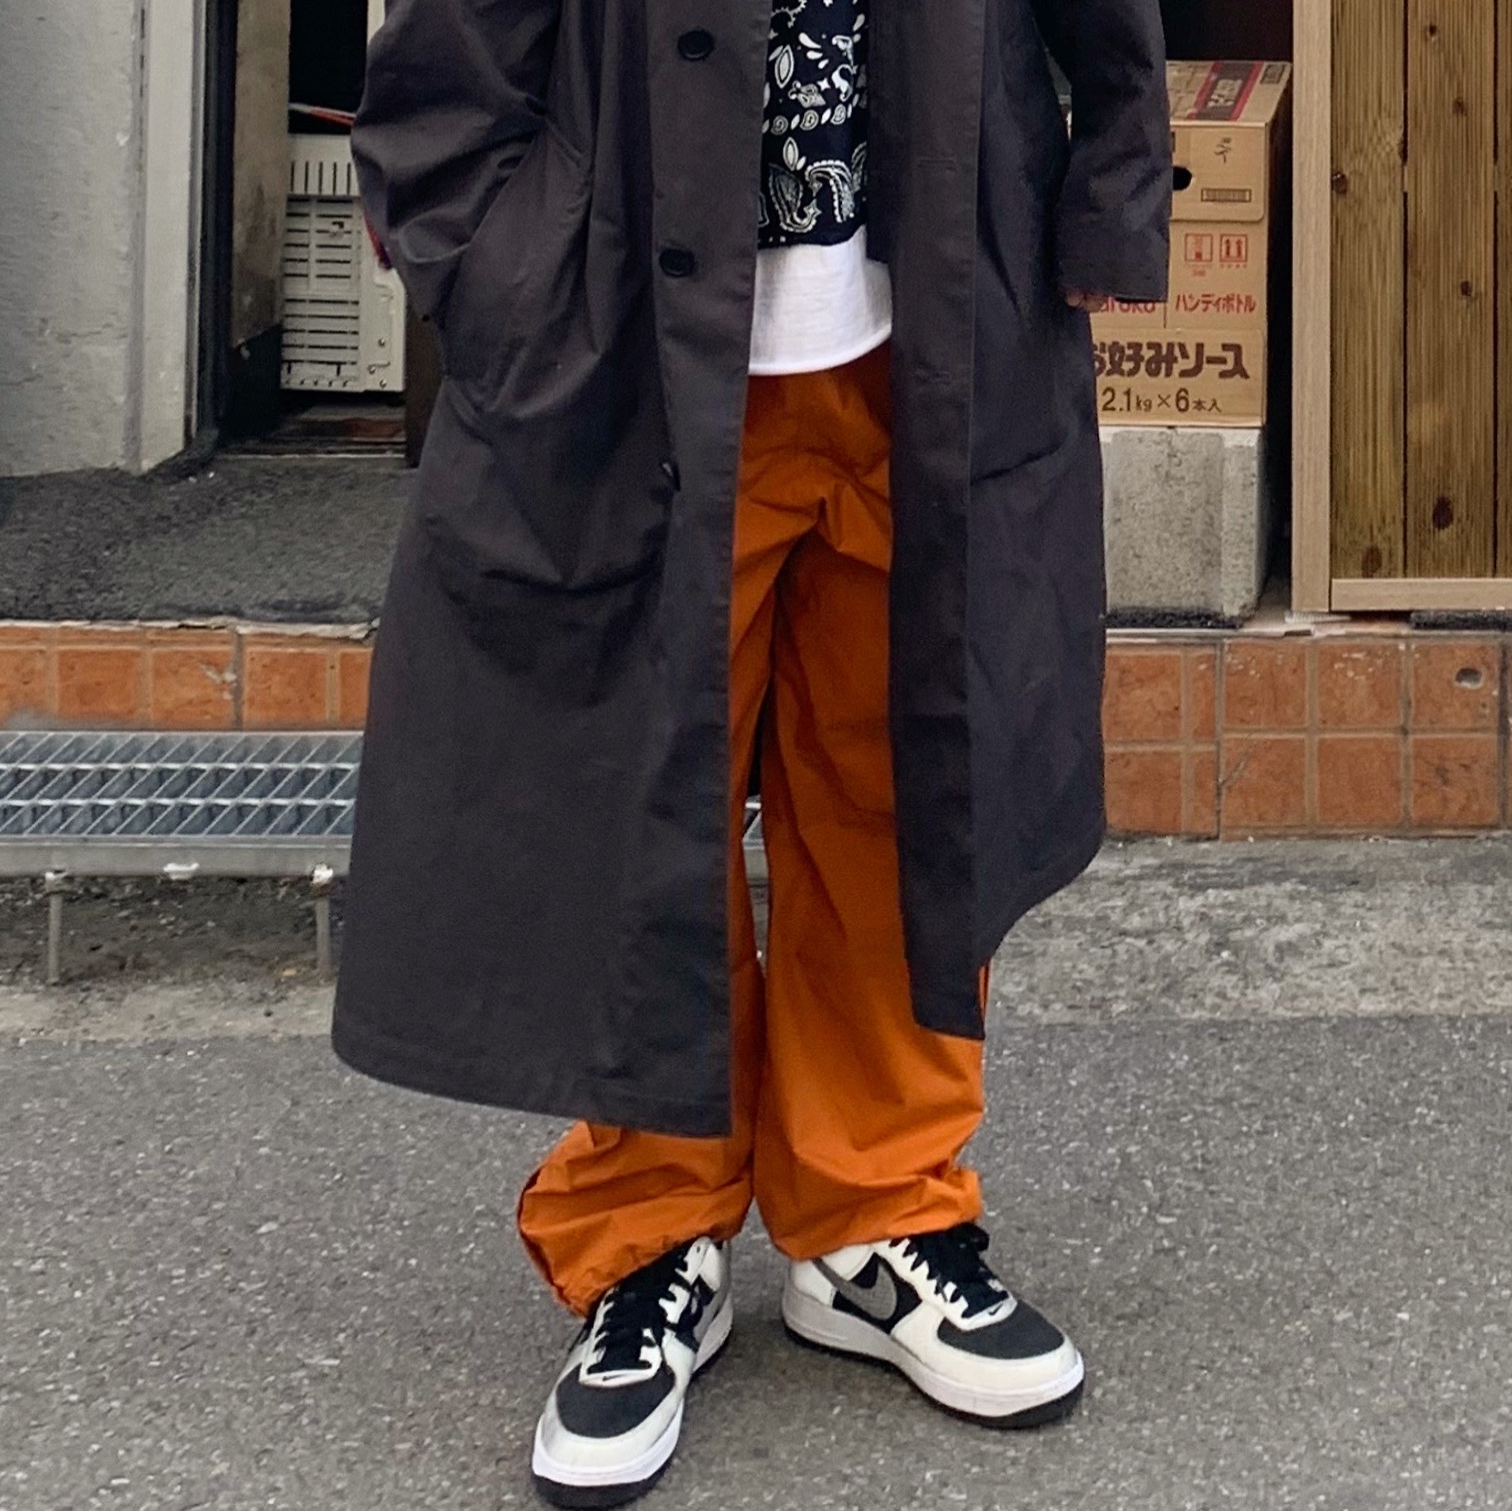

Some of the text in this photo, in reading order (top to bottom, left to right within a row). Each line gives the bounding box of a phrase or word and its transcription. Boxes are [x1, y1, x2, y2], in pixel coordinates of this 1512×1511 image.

[1175, 293, 1256, 314] ハンディボトル
[1093, 341, 1249, 379] お好みソース
